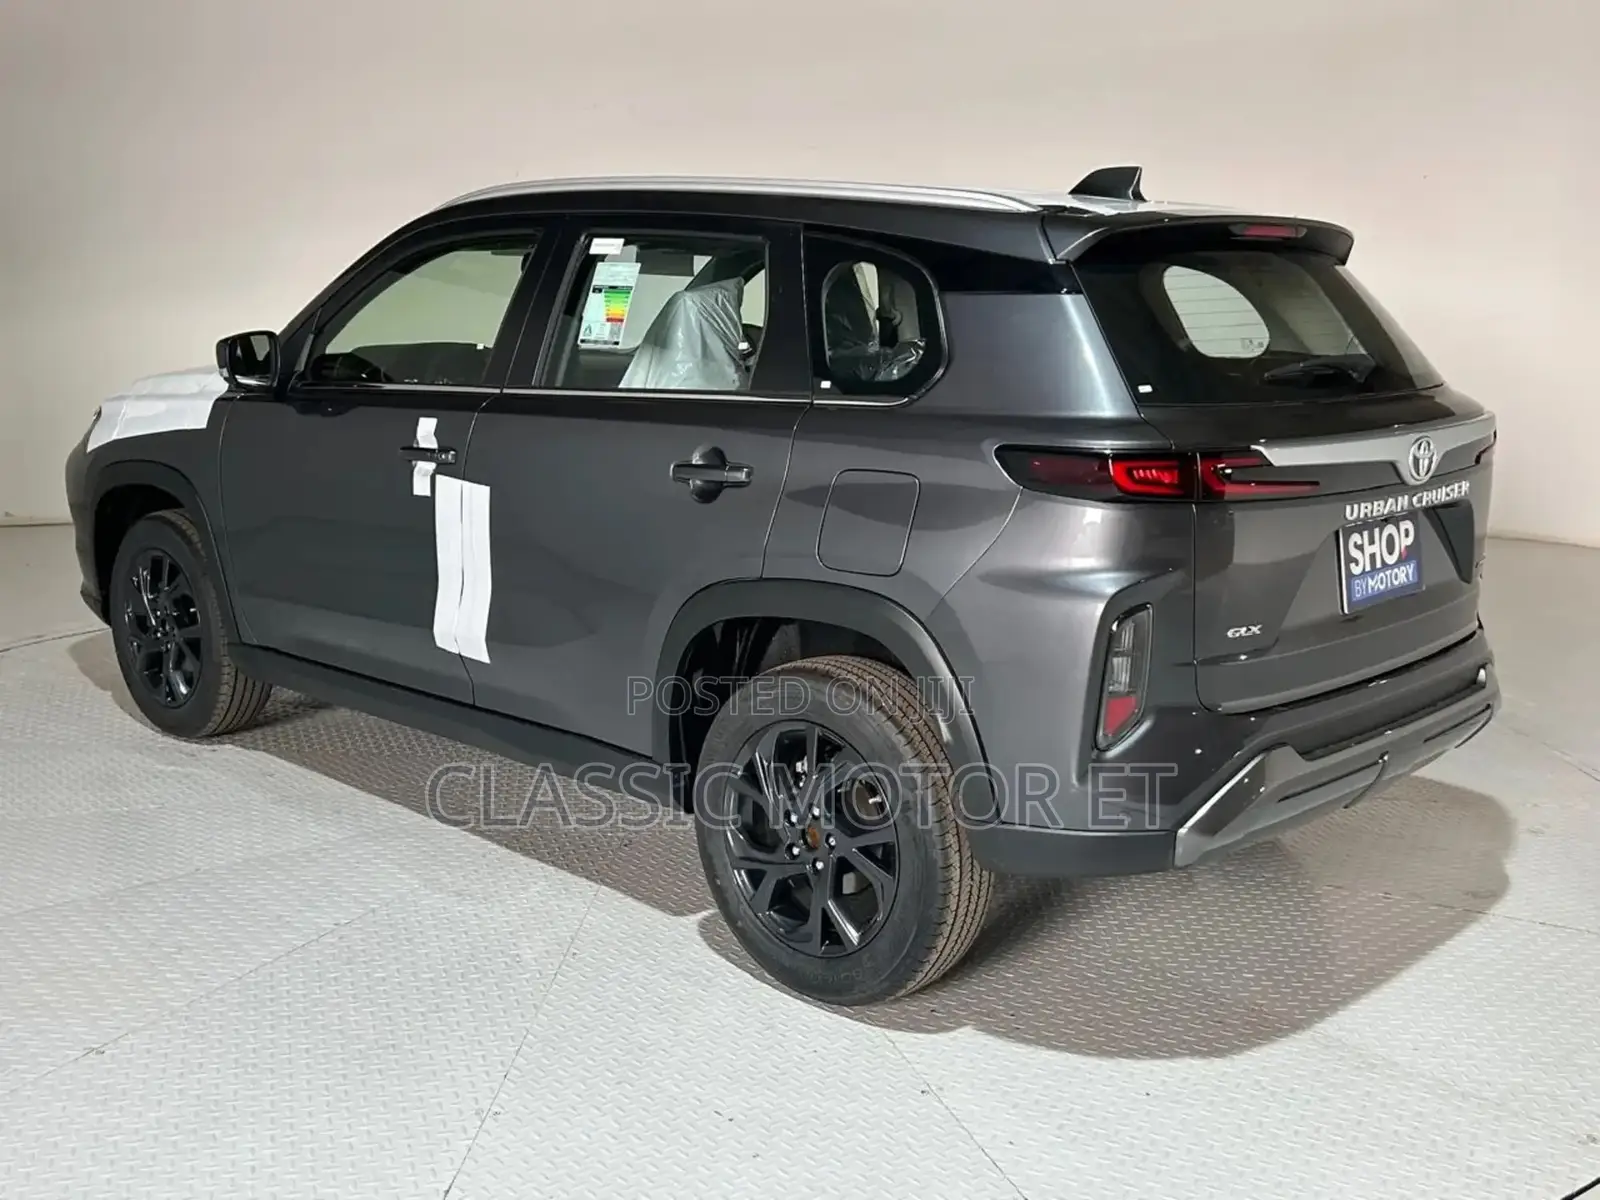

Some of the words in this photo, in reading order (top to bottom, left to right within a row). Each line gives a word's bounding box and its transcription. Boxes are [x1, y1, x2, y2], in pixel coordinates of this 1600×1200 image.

[1345, 495, 1408, 520] URBAN
[1412, 480, 1470, 507] CRUISER
[1348, 520, 1414, 575] SHOP
[1354, 579, 1368, 597] BY
[1368, 563, 1415, 593] MOTORY
[1227, 624, 1263, 638] GLX
